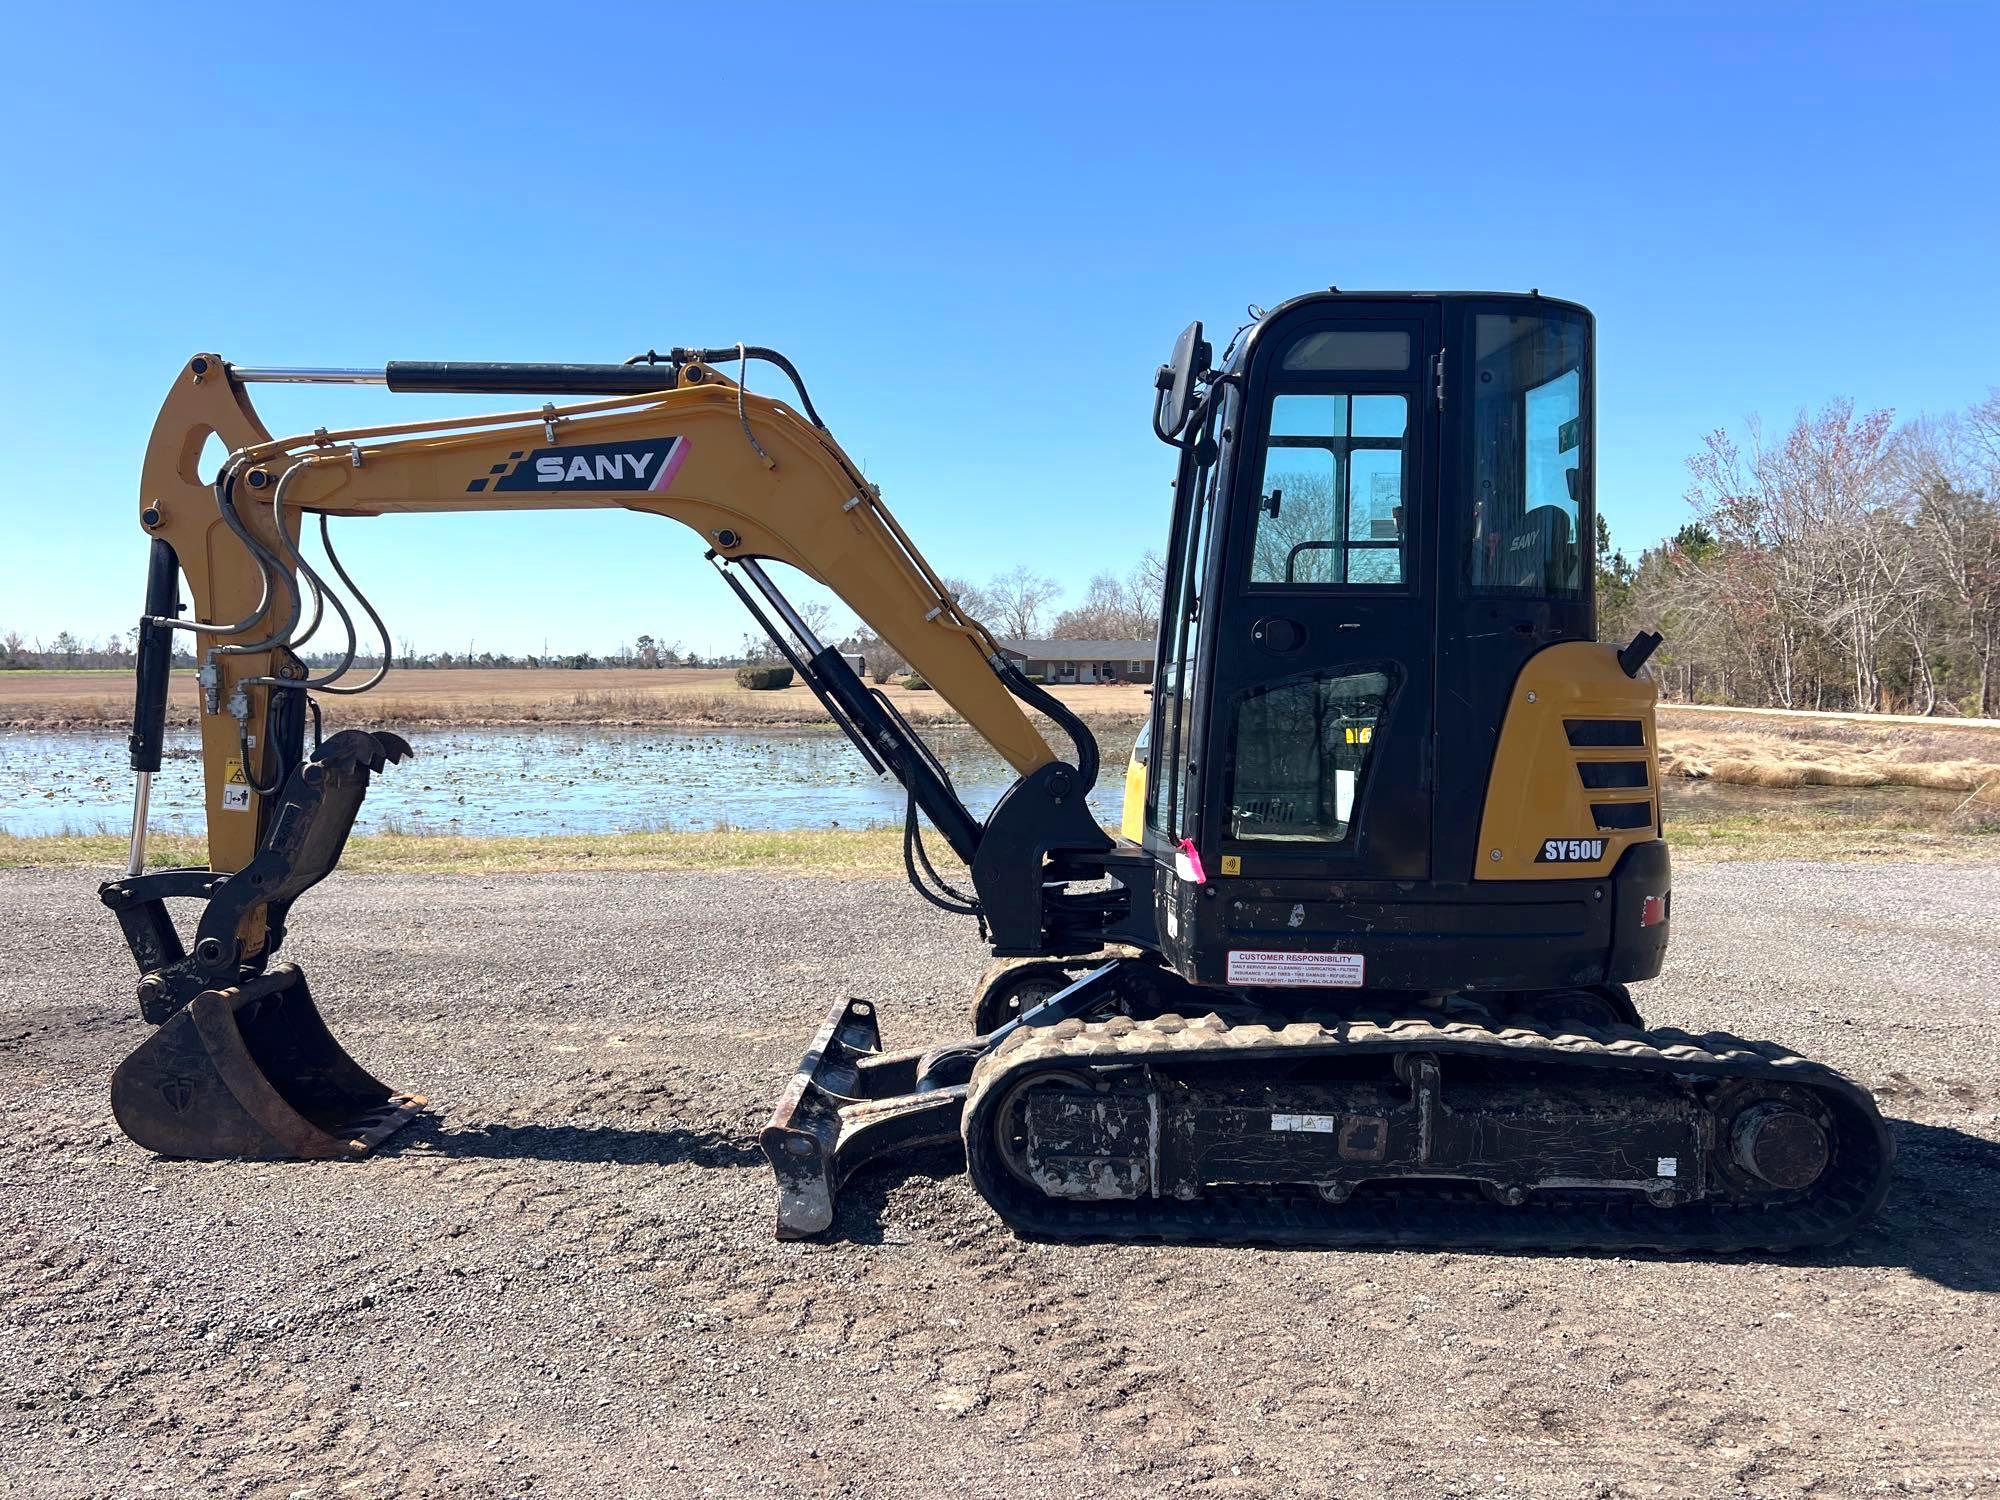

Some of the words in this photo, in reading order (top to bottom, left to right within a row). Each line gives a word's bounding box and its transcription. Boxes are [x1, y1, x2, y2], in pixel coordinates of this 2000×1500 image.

[535, 453, 654, 483] SANY
[1510, 529, 1540, 552] SANY
[1545, 840, 1602, 860] SY50U
[1239, 953, 1284, 961] CUSTOMER
[1286, 954, 1352, 963] RESPONSIBILITY
